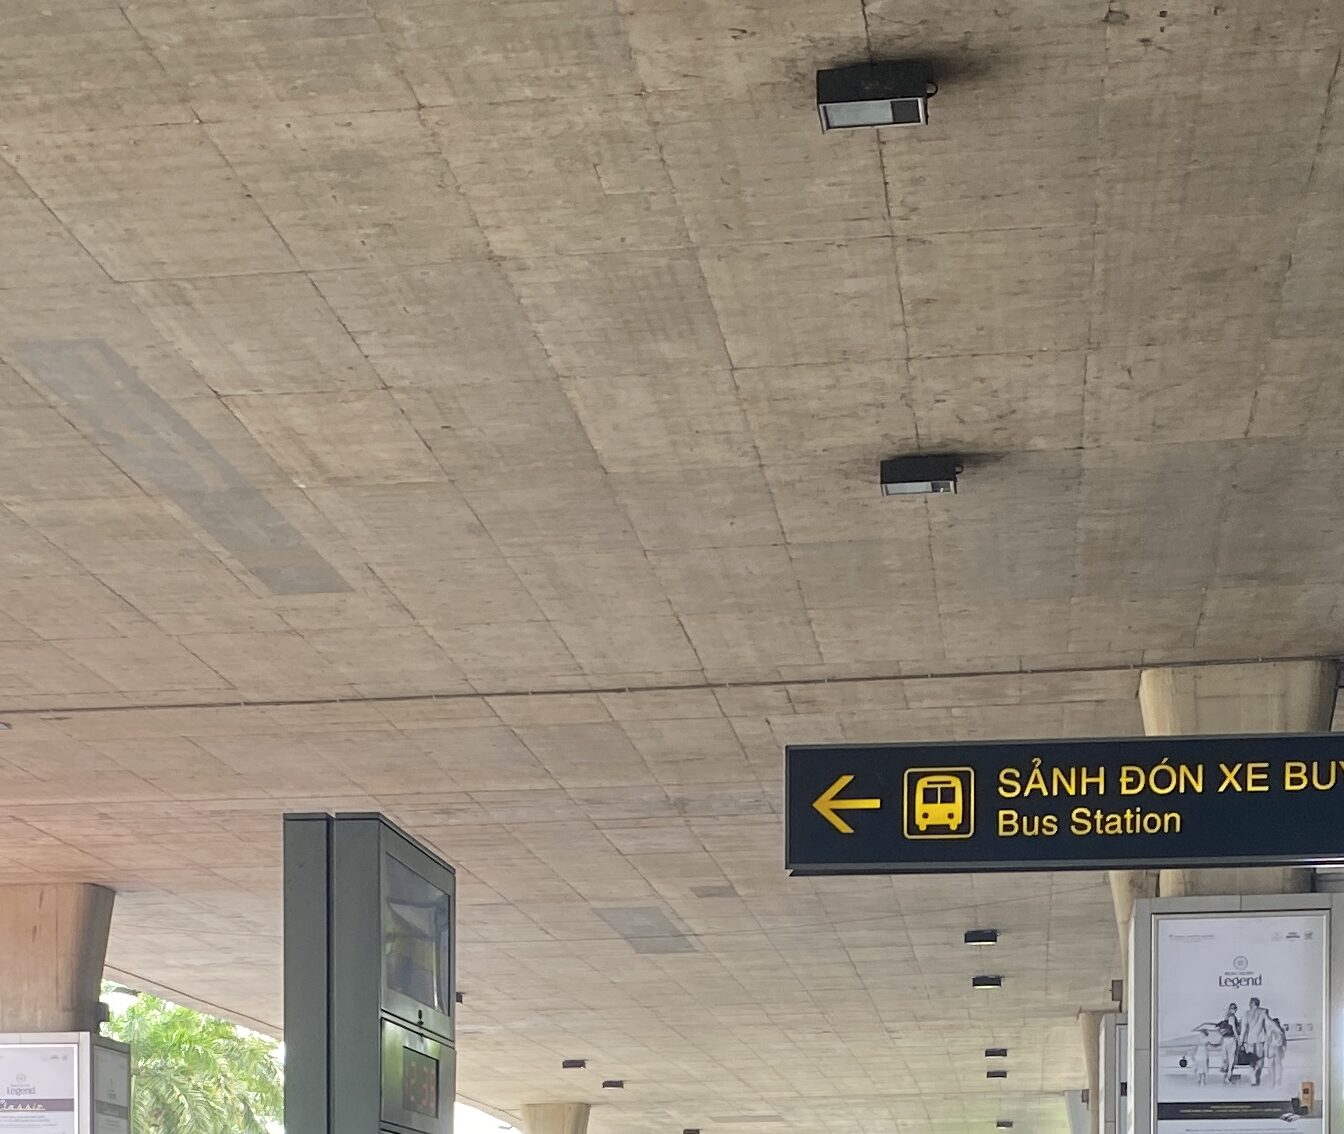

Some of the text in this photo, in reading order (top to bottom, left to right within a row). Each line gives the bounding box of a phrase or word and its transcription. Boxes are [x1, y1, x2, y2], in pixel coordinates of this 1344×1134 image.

[997, 757, 1106, 798] SẢNH
[1119, 757, 1205, 796] ĐÓN
[1217, 761, 1270, 793] XE
[997, 806, 1182, 837] Bus Station
[1218, 973, 1263, 989] Legend
